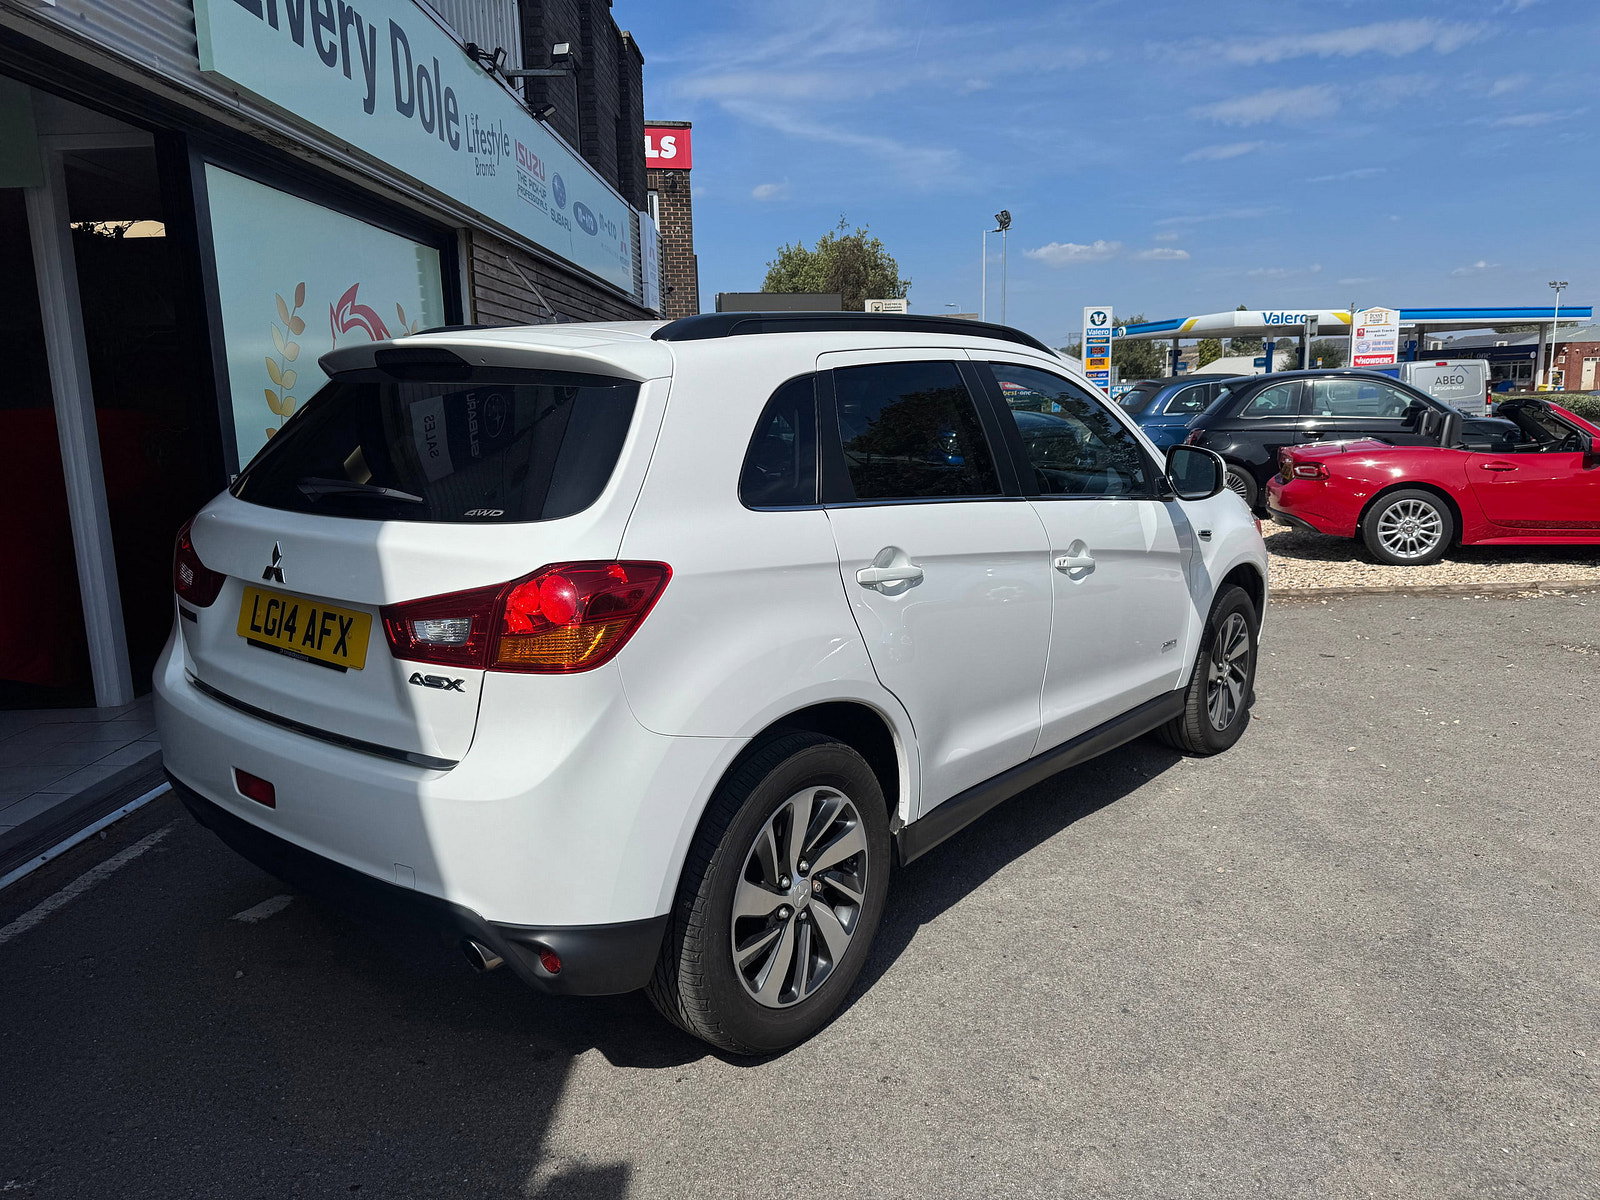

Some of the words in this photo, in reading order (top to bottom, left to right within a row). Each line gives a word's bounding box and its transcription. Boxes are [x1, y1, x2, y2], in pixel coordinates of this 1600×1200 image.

[389, 18, 460, 151] Dole
[465, 113, 510, 165] Lifestyle
[645, 135, 677, 159] LS
[475, 157, 496, 177] Brands
[515, 139, 546, 181] ISUZU
[551, 209, 572, 232] SUBARU
[1263, 312, 1307, 325] Valero
[1361, 356, 1392, 364] HOWDENS
[1435, 375, 1465, 385] ABEO
[464, 508, 505, 517] 4WD
[250, 594, 299, 643] LG14
[302, 608, 354, 658] AFX
[408, 672, 465, 693] ASX
